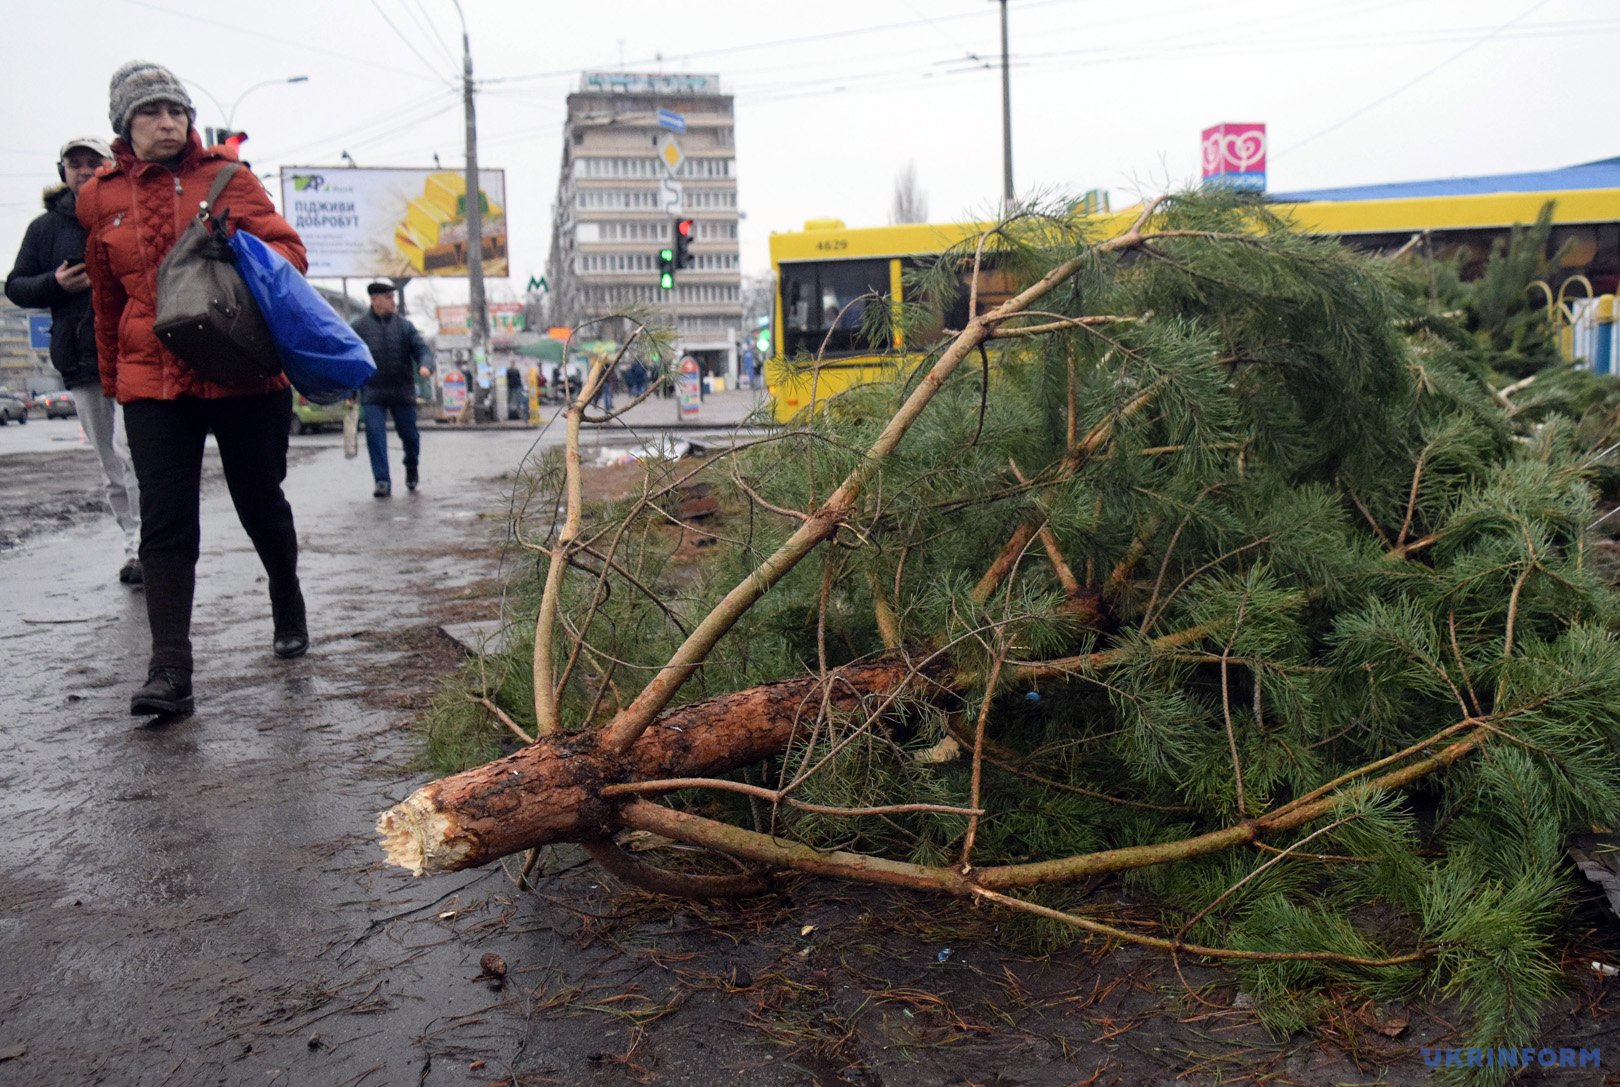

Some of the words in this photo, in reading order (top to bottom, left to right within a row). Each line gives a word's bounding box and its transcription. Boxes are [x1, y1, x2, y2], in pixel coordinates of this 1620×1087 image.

[294, 201, 355, 213] ПІДЖИВИ
[295, 215, 359, 229] ДОБРОБУТ
[816, 240, 848, 251] 4629
